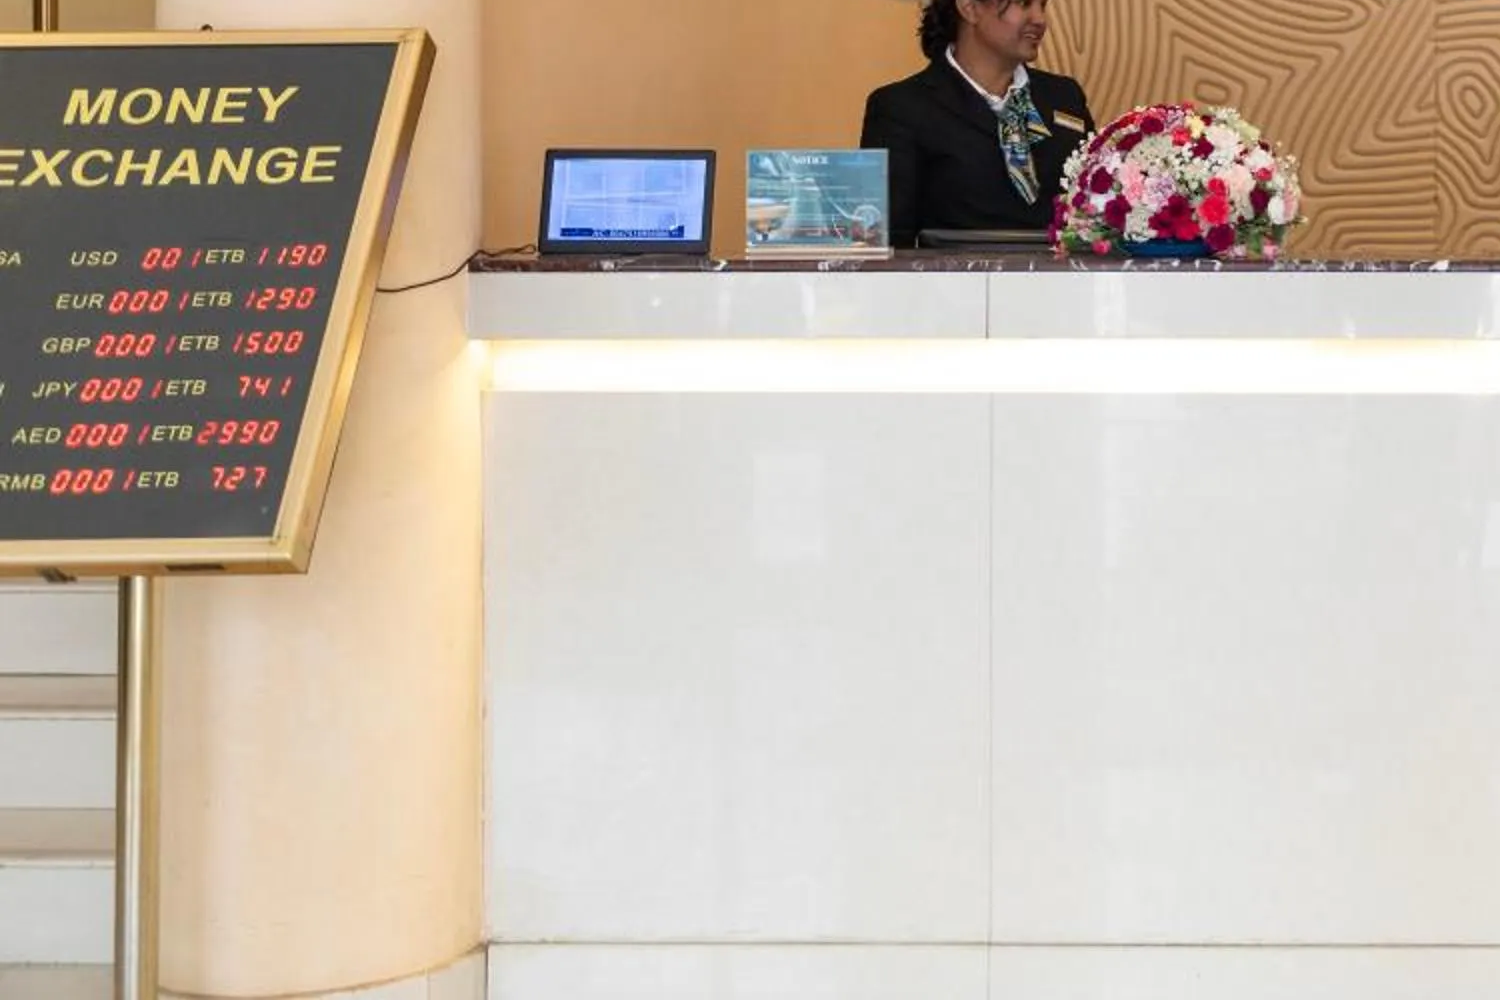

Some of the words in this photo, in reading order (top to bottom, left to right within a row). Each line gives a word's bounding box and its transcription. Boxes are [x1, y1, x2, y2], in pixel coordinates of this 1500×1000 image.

[63, 85, 300, 126] MONEY
[0, 145, 342, 187] EXCHANGE
[71, 250, 118, 266] USD
[141, 247, 202, 271] 001
[205, 248, 246, 265] ETB
[257, 244, 328, 266] 1190
[56, 293, 105, 311] EUR
[192, 291, 233, 308] ETB
[245, 287, 318, 310] 1290
[42, 337, 92, 354] GBP
[179, 336, 220, 352] ETB
[232, 331, 304, 356] 1500
[31, 381, 78, 399] JPY
[165, 379, 208, 396] ETB
[238, 375, 294, 397] 741
[11, 426, 62, 444] AED
[151, 425, 194, 442] ETB
[196, 420, 282, 445] 2990
[0, 472, 46, 491] RMB
[137, 471, 180, 488] ETB
[210, 466, 269, 491] 727
